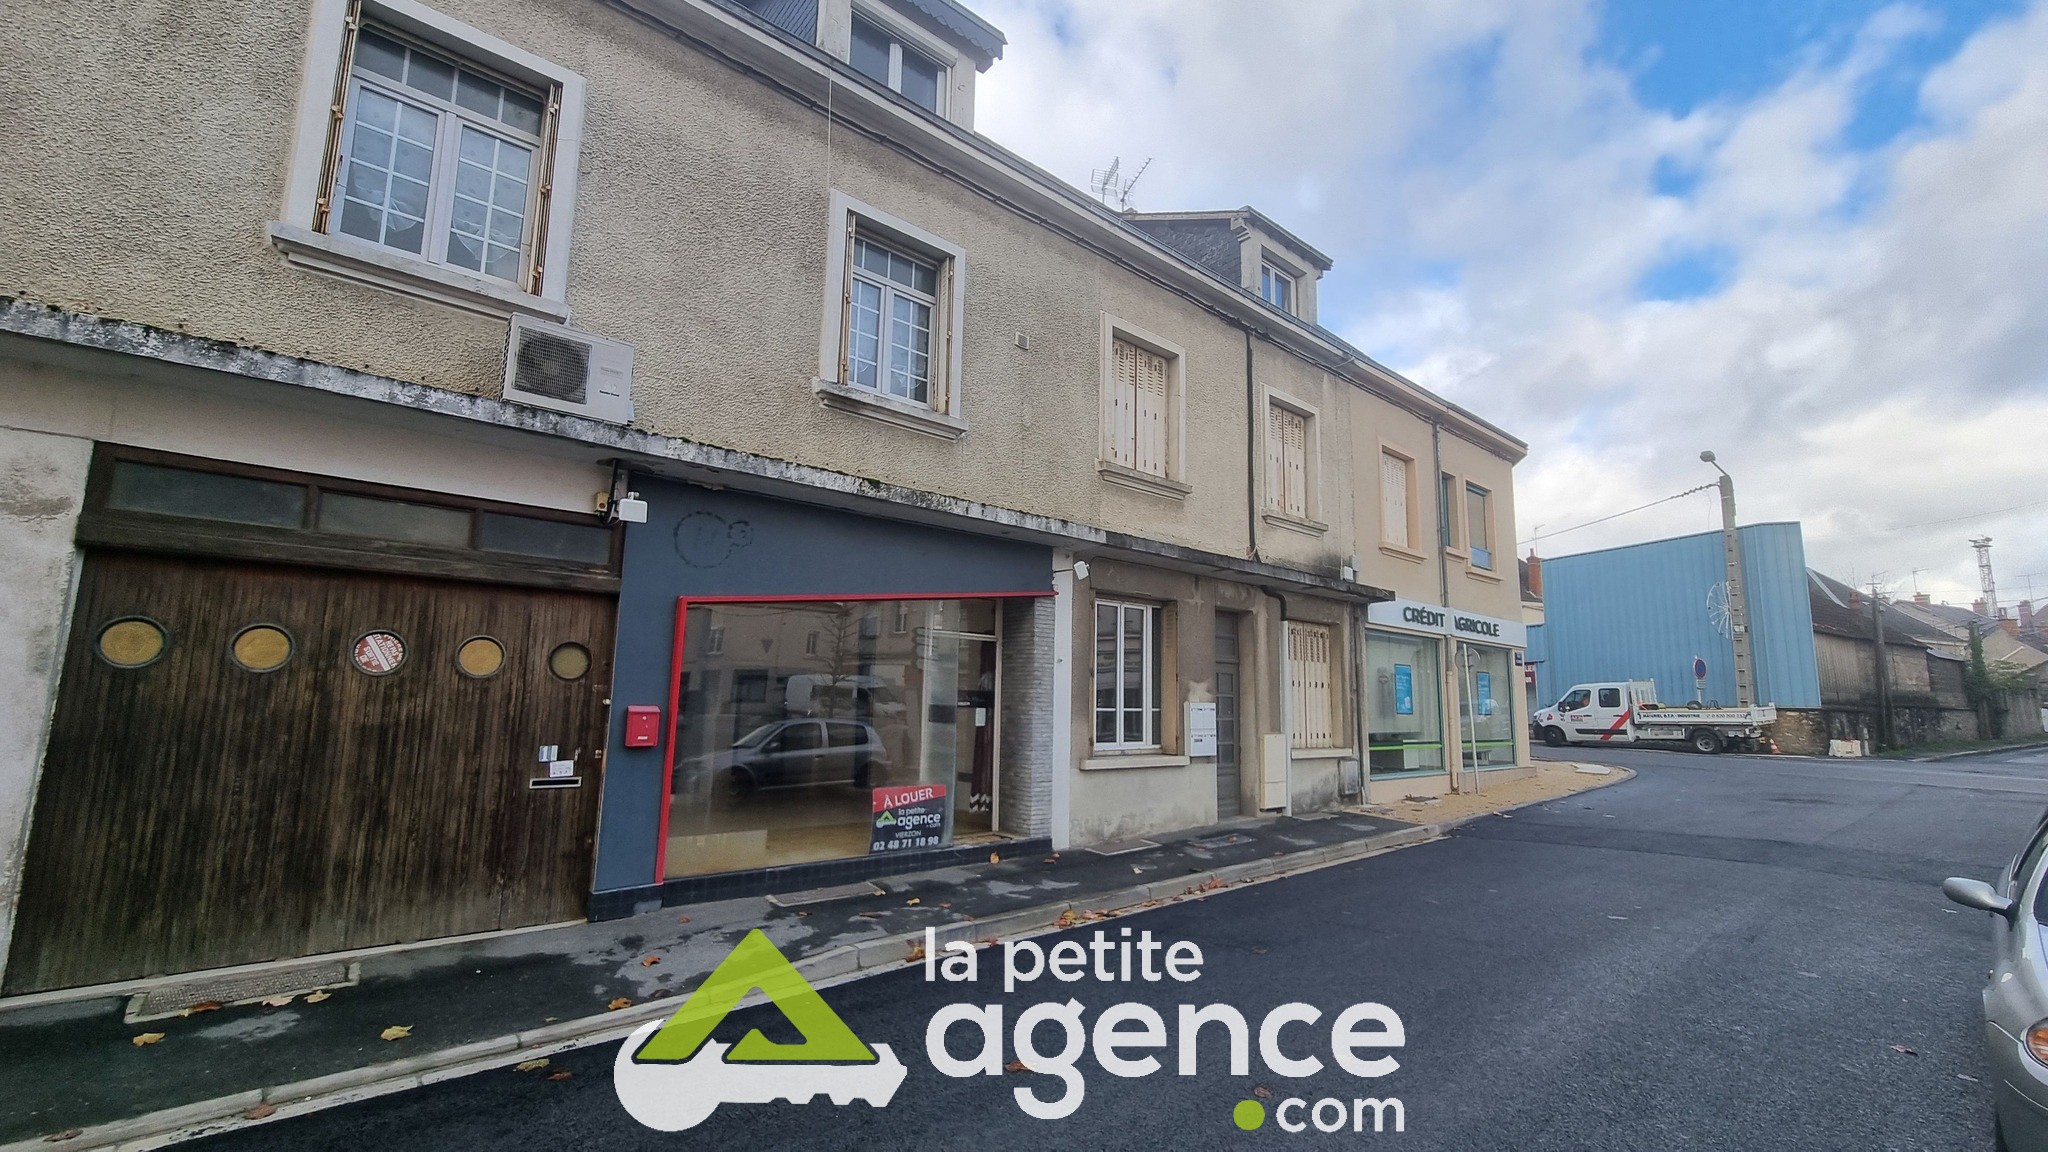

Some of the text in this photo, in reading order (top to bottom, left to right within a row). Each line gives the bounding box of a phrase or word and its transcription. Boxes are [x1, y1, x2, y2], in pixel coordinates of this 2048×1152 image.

[1403, 606, 1445, 627] CRÉDIT
[894, 787, 934, 807] LOUER
[906, 807, 926, 816] petite
[897, 813, 941, 830] agence
[895, 830, 922, 838] VIERZON
[873, 841, 885, 850] 02
[887, 840, 900, 849] 48
[902, 839, 912, 848] 71
[916, 837, 926, 846] 18
